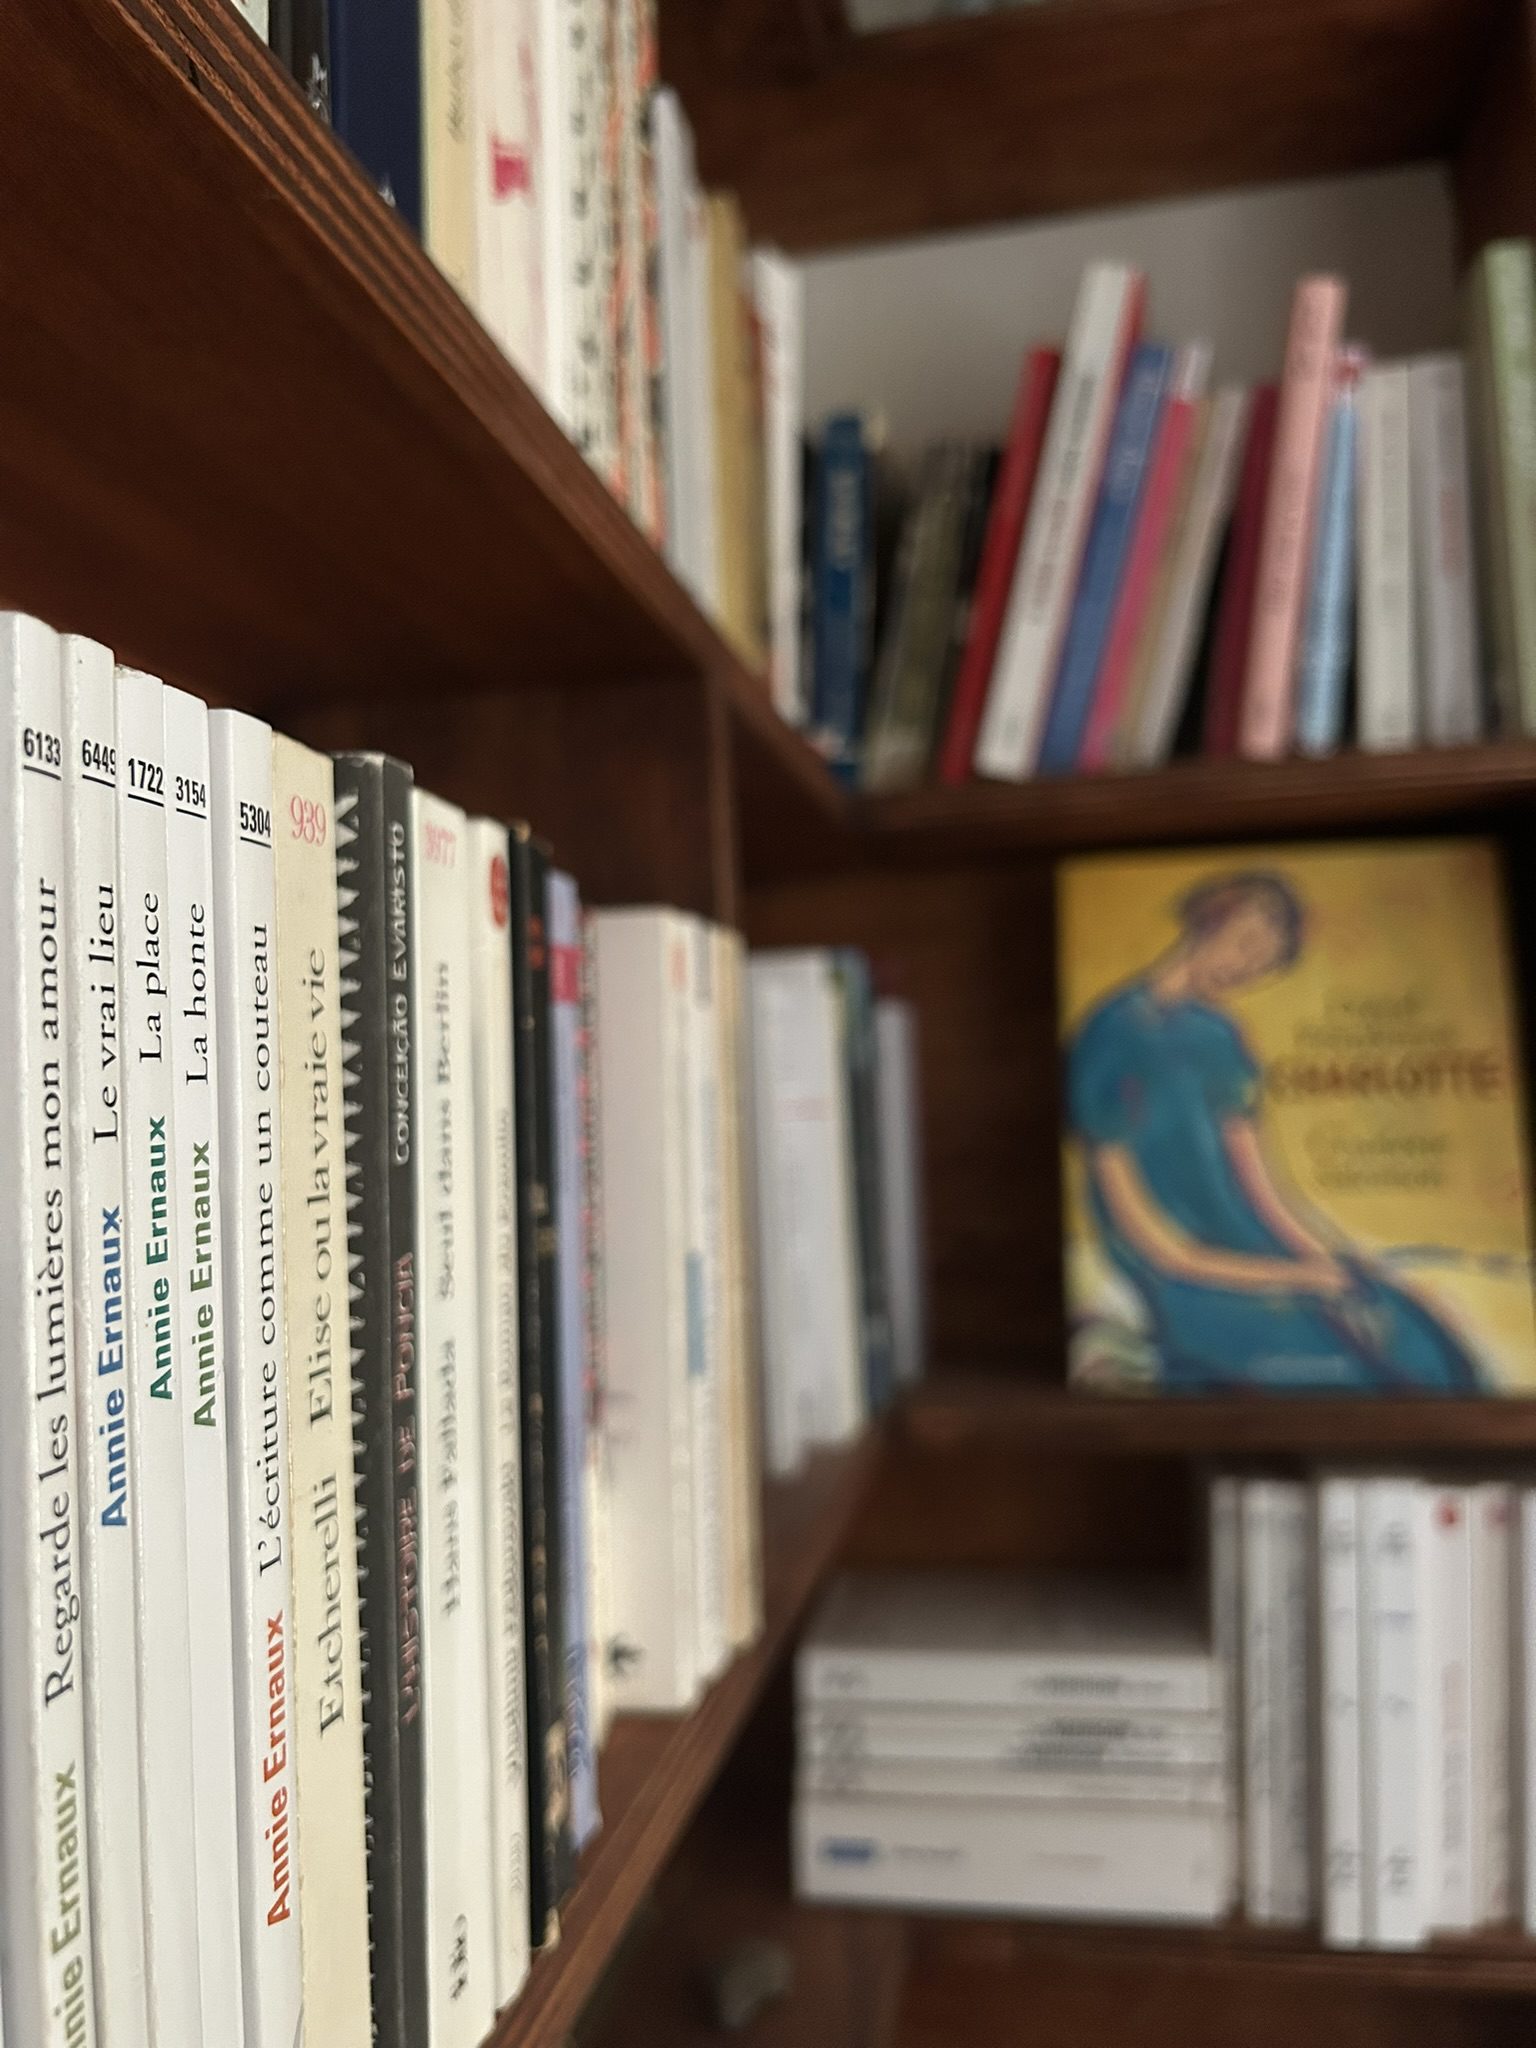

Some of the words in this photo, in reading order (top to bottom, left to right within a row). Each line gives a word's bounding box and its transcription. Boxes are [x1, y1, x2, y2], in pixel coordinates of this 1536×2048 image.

[24, 727, 61, 767] 6133
[82, 739, 117, 776] 6449
[128, 758, 164, 795] 1722
[175, 776, 207, 808] 3154
[240, 801, 272, 838] 5304
[289, 794, 327, 848] 939
[39, 877, 61, 1039] amour
[89, 884, 115, 963] lieu
[135, 892, 168, 997] place
[183, 903, 207, 1023] honte
[301, 946, 326, 1012] vie
[90, 983, 117, 1070] vrai
[140, 1011, 163, 1064] La
[186, 1034, 208, 1085] La
[252, 923, 272, 1091] couteau
[43, 1059, 63, 1169] mon
[93, 1085, 120, 1144] Le
[257, 1109, 272, 1163] un
[304, 1033, 331, 1158] vraie
[145, 1115, 169, 1265] Ernaux
[189, 1140, 213, 1292] Ernaux
[307, 1168, 332, 1208] la
[36, 1187, 68, 1403] lumières
[98, 1205, 124, 1376] Ernaux
[259, 1182, 277, 1345] comme
[315, 1217, 333, 1280] ou
[147, 1276, 173, 1400] Annie
[190, 1303, 217, 1427] Annie
[308, 1295, 334, 1431] Elise
[39, 1413, 70, 1484] les
[99, 1387, 128, 1527] Annie
[256, 1360, 283, 1577] L'écriture
[40, 1492, 81, 1709] Regarde
[315, 1473, 346, 1738] Etcherelli
[263, 1609, 288, 1783] Ernaux
[51, 1759, 83, 1956] Ernaux
[265, 1785, 291, 1927] Annie
[53, 1955, 86, 2048] nie
